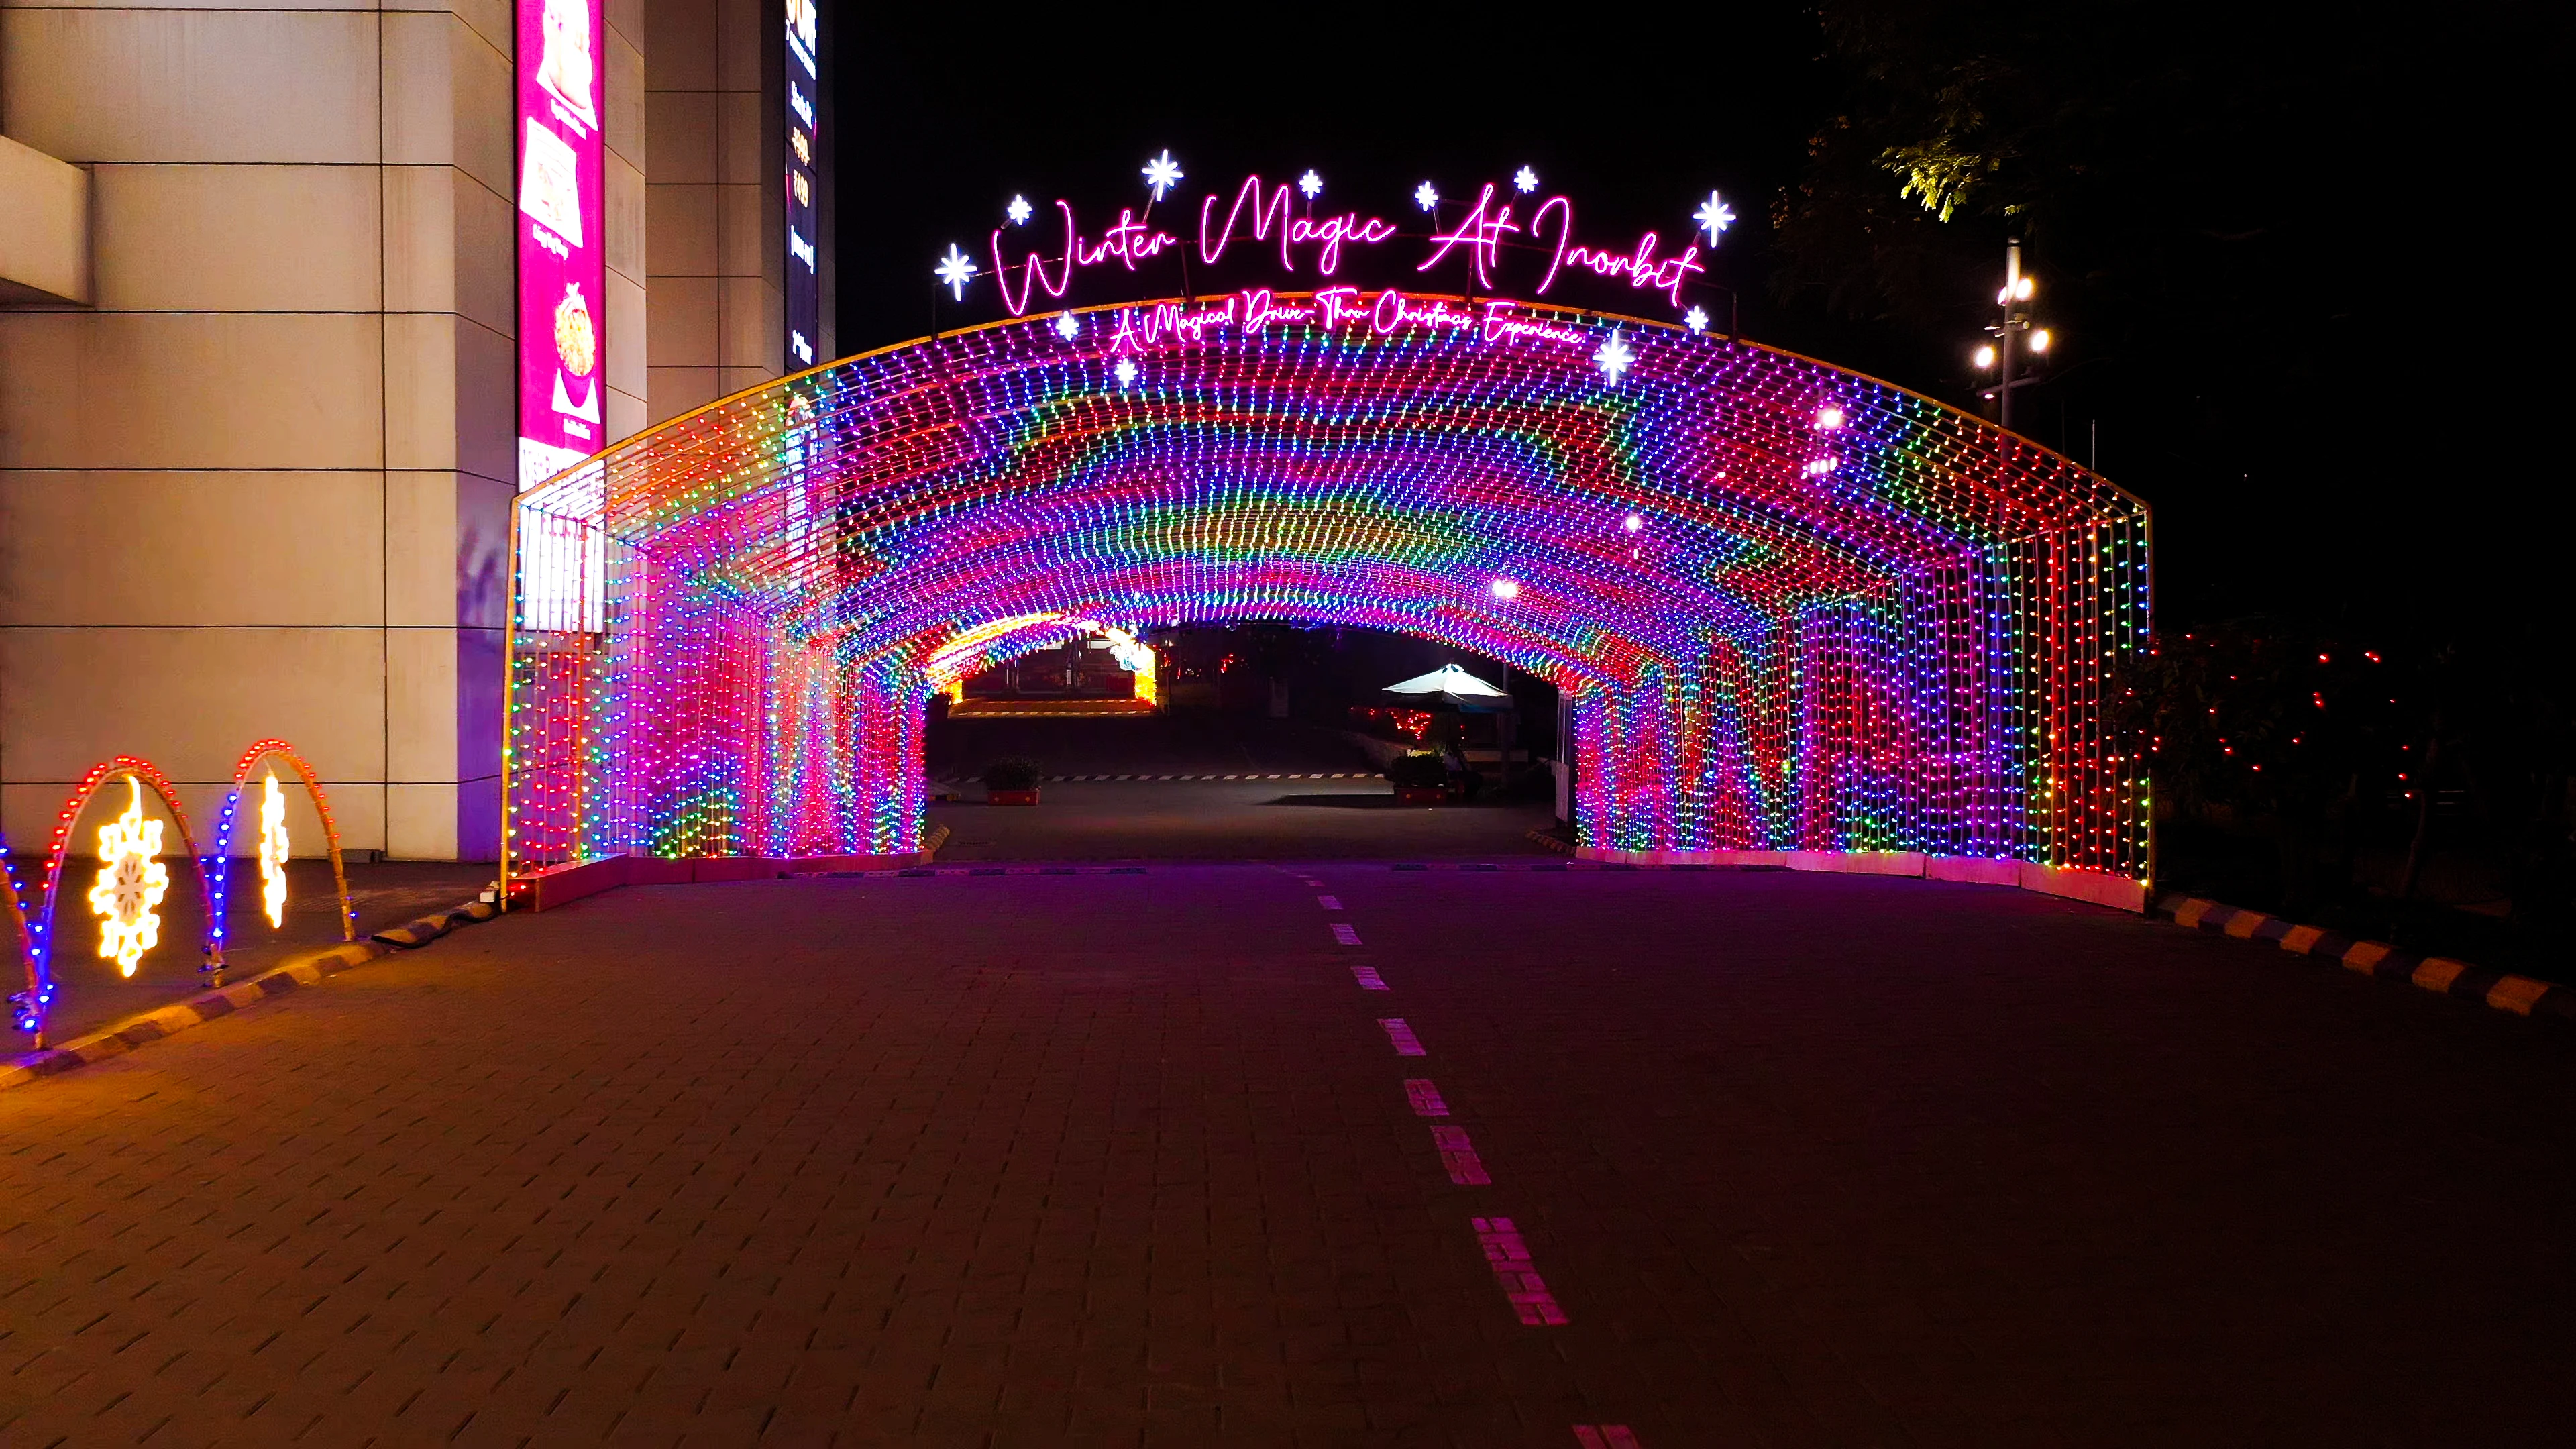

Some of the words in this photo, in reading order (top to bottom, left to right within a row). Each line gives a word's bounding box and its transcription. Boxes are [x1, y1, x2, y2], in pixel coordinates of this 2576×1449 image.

[993, 201, 1176, 316] Winter
[1201, 176, 1397, 275] Magic
[1417, 184, 1520, 289] At
[1532, 197, 1705, 307] Inorbit
[1110, 307, 1144, 354] A
[1144, 297, 1234, 343] Magical
[1375, 290, 1472, 333] Christmas
[1483, 301, 1584, 347] Experience
